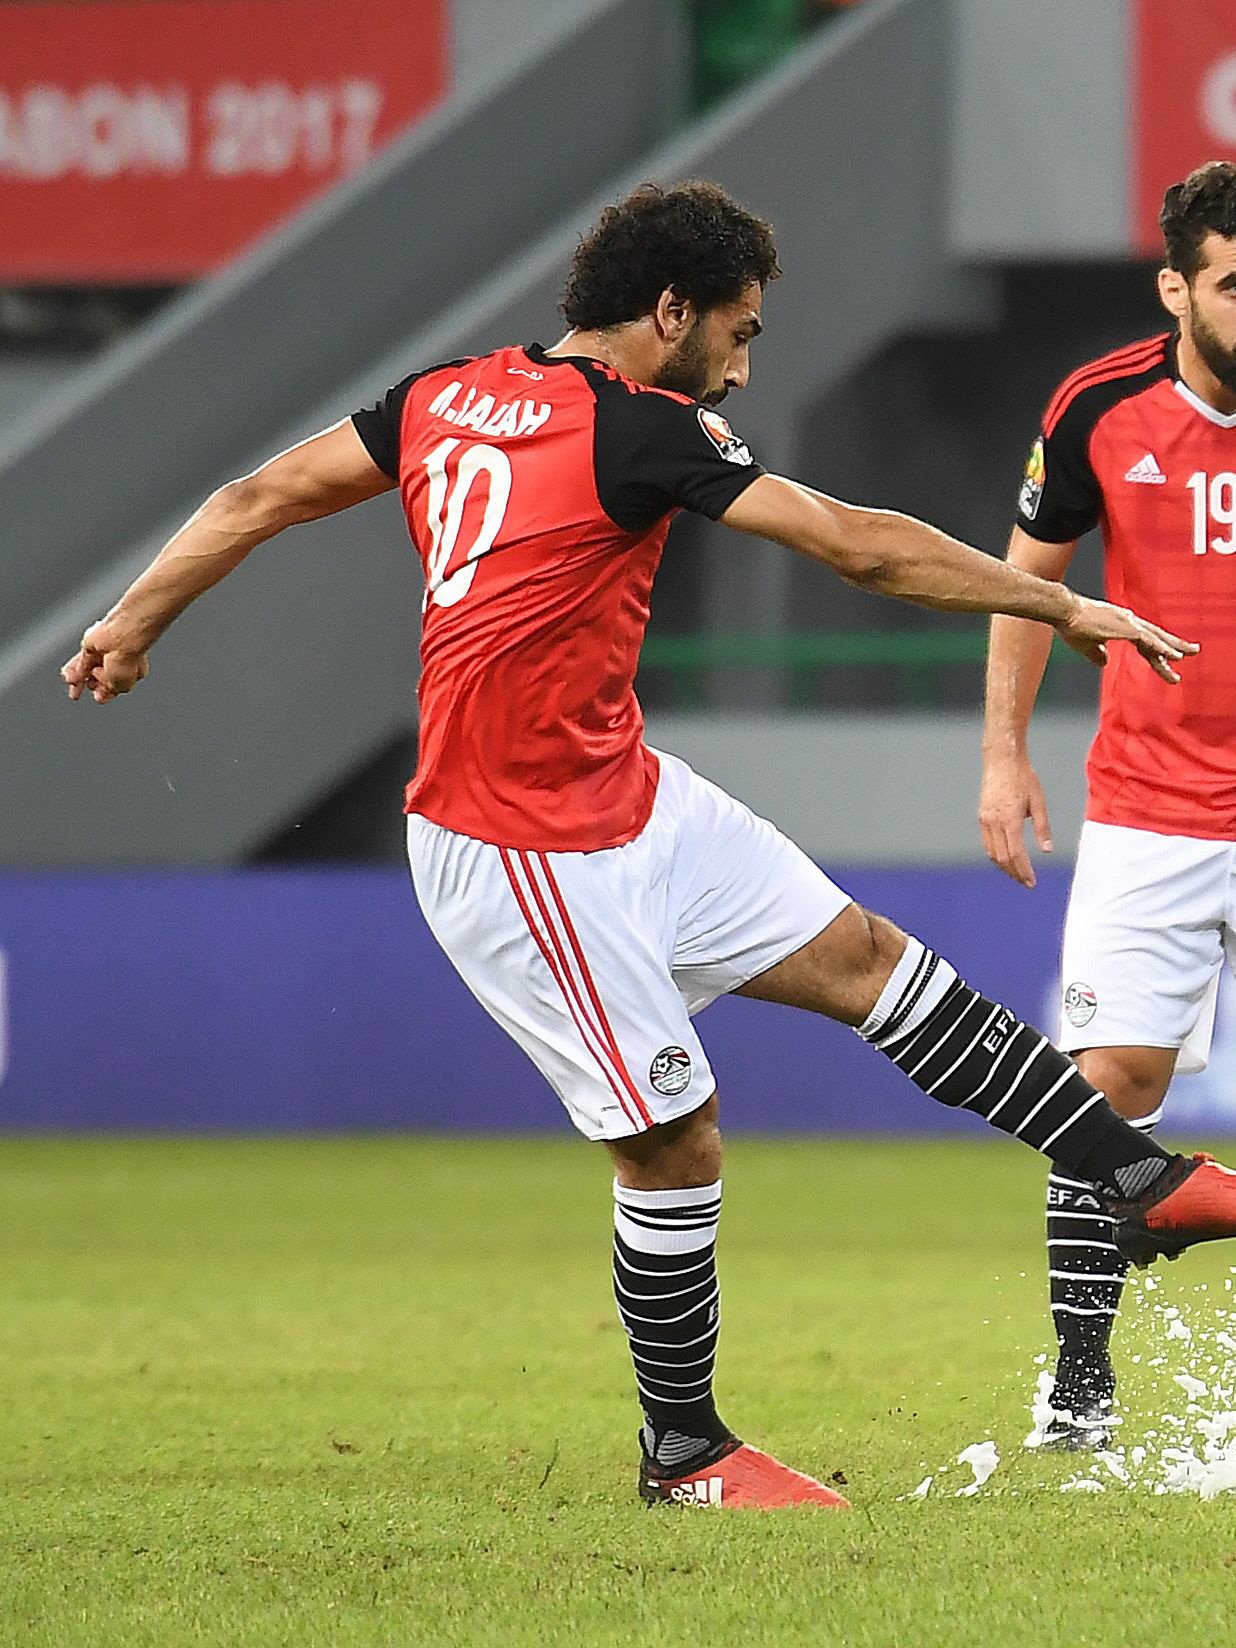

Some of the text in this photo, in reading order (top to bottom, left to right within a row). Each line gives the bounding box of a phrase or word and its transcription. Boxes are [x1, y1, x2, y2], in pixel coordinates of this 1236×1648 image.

[207, 81, 382, 175] 2017
[421, 437, 512, 608] 10
[1047, 1186, 1101, 1209] EFA
